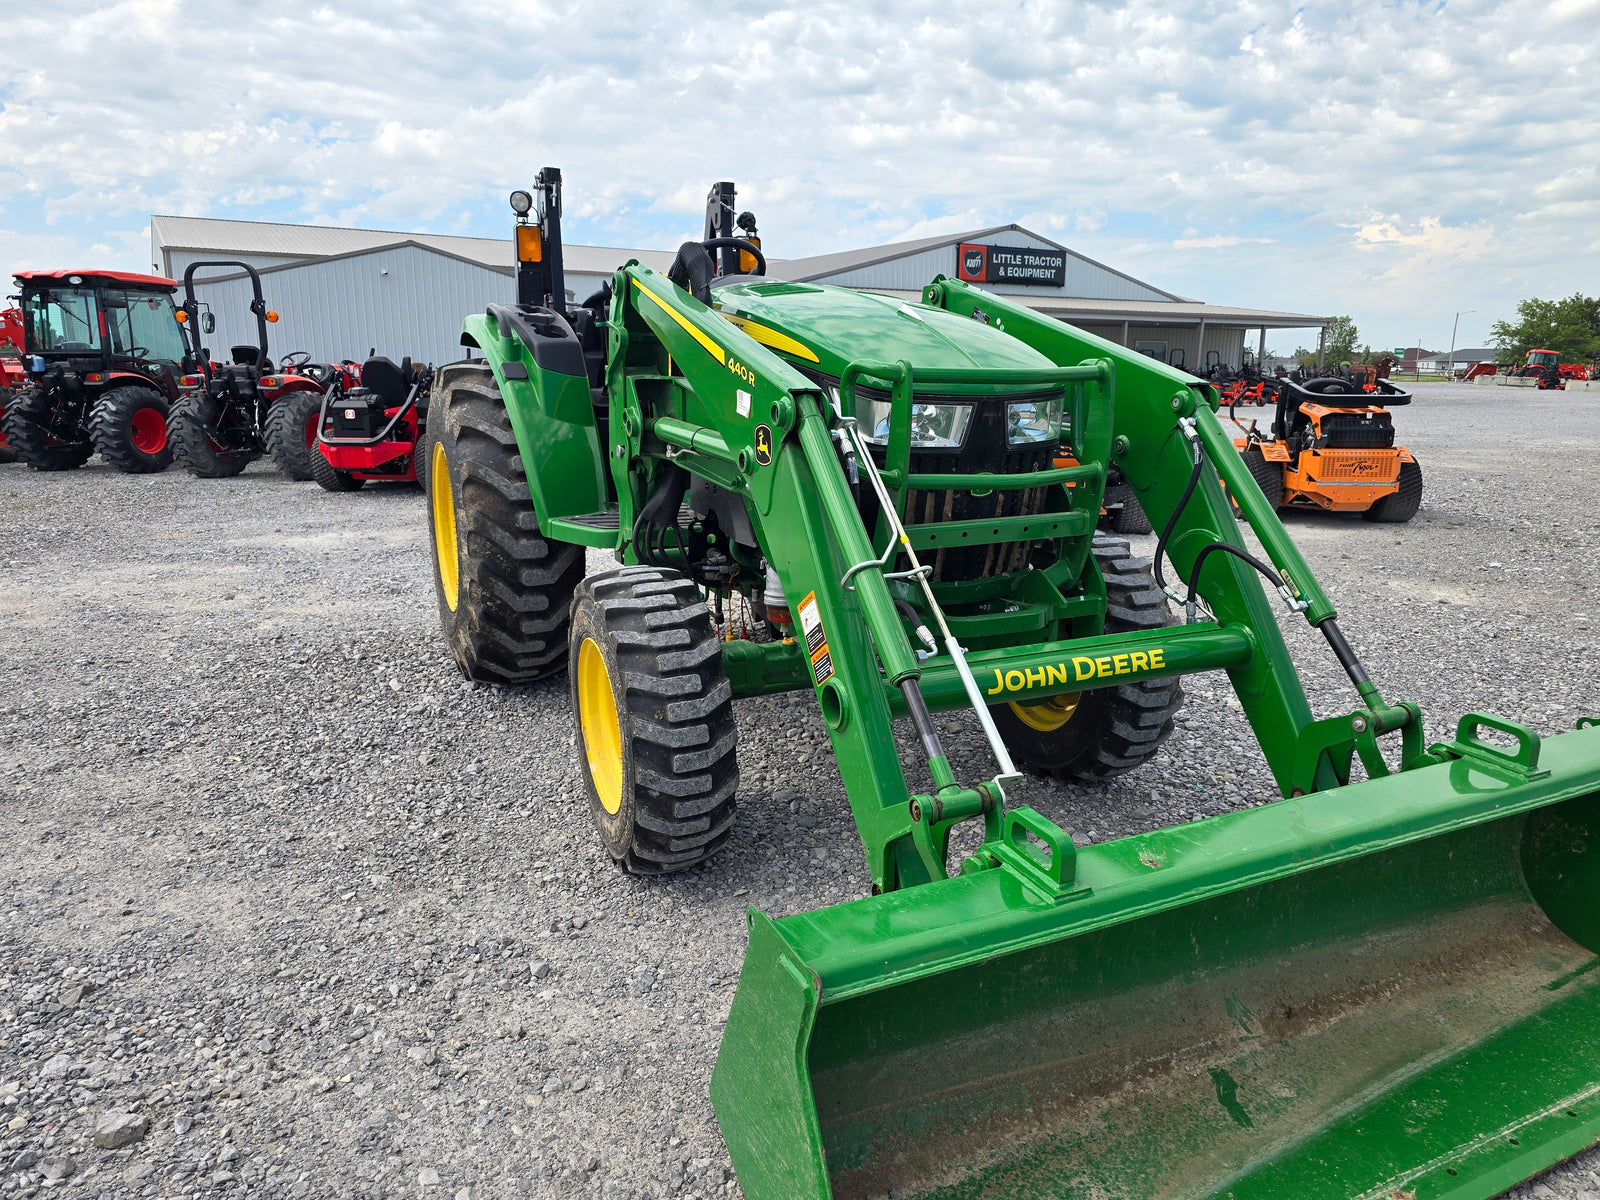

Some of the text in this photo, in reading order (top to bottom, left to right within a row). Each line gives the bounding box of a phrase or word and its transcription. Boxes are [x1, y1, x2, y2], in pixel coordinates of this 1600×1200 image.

[993, 254, 1062, 267] LITTLE TRACTOR
[999, 267, 1056, 279] & EQUIPMENT
[988, 648, 1166, 695] JOHN DEERE
